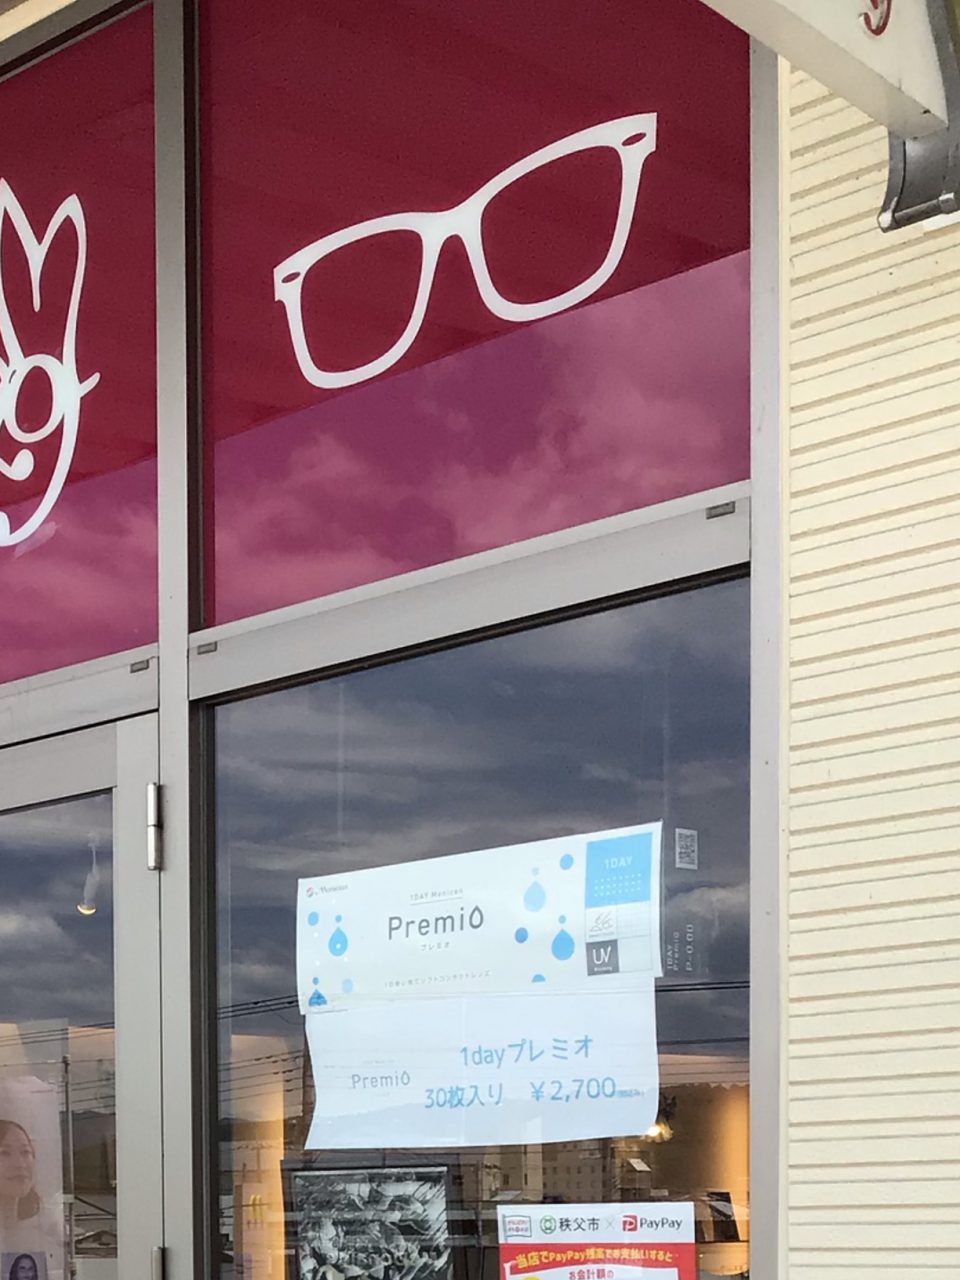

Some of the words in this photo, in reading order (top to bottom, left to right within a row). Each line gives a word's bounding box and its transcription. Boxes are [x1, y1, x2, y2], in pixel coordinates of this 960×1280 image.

[604, 855, 633, 869] 1DAY
[592, 946, 612, 965] UV
[424, 1082, 504, 1109] 30枚入り
[559, 1217, 600, 1232] 秩父市
[640, 1217, 683, 1231] PayPay
